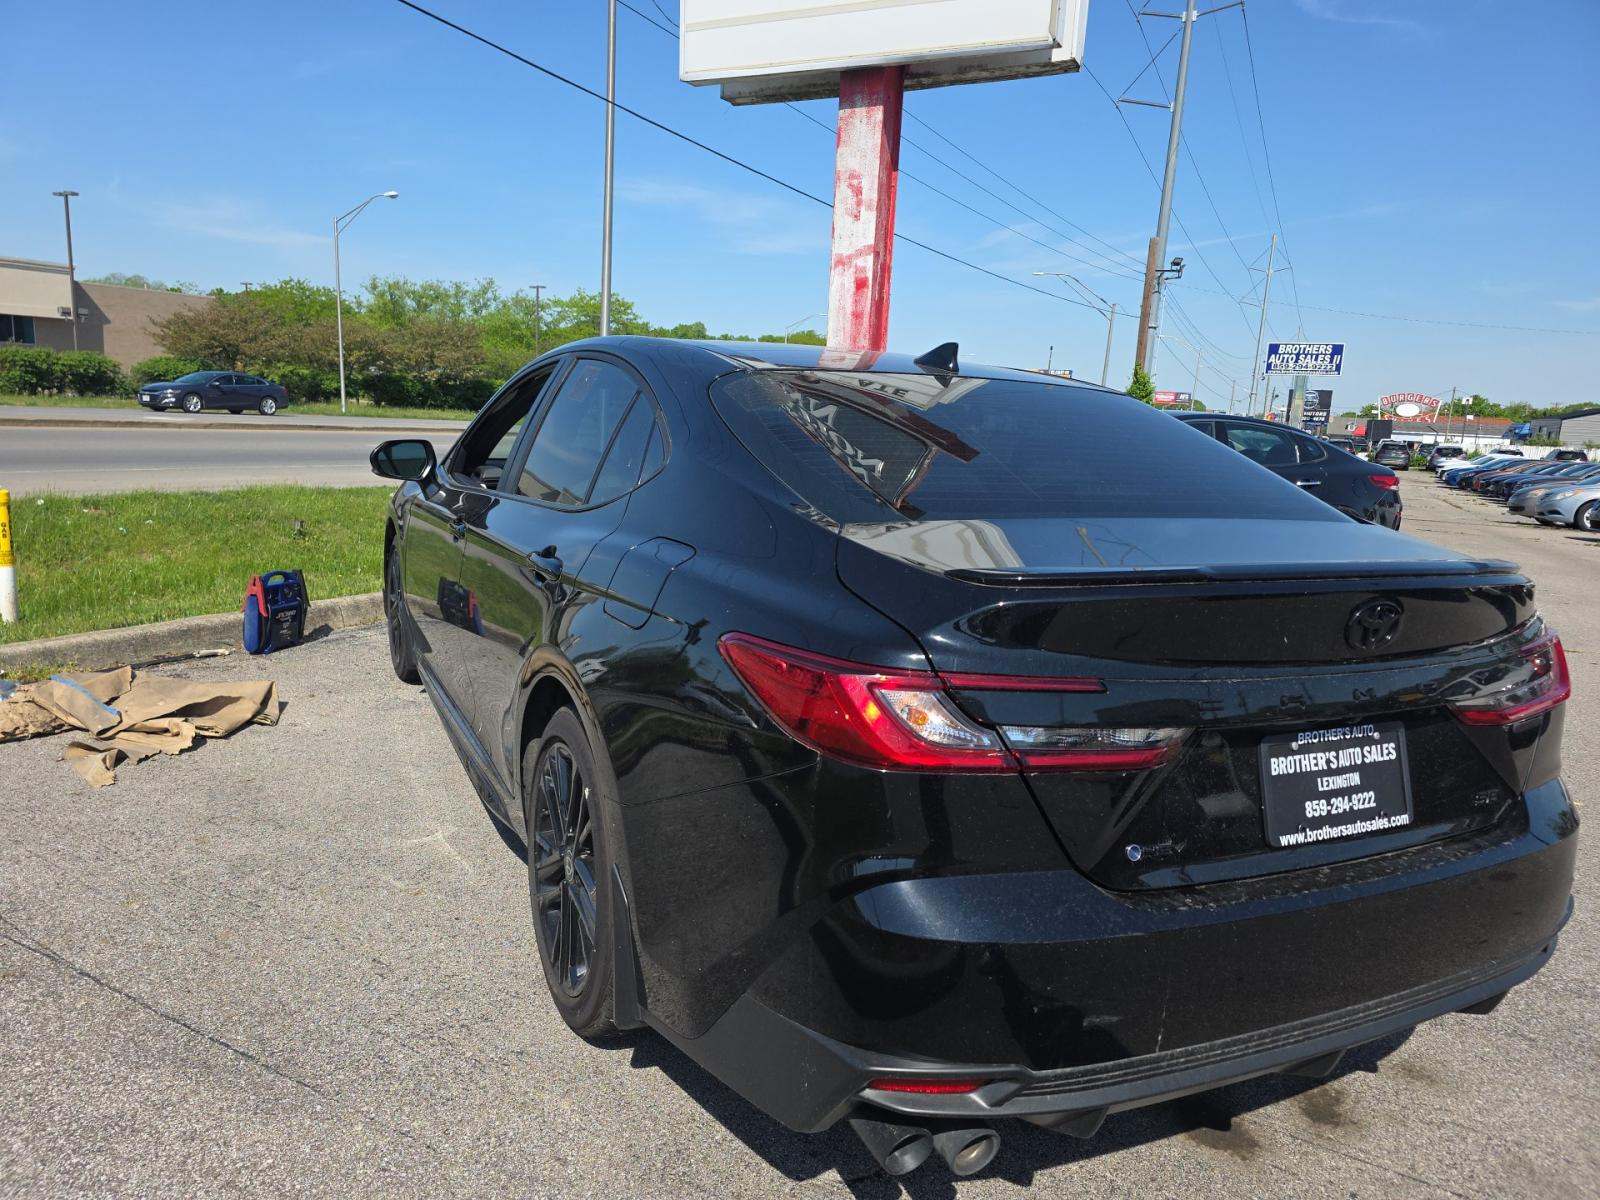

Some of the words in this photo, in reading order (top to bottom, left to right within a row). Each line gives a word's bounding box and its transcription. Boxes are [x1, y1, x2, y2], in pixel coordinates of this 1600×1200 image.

[1268, 355, 1296, 364] AUTO
[1298, 355, 1331, 364] SALES
[1278, 345, 1333, 354] BROTHERS
[1382, 393, 1439, 407] BURGERS
[1297, 727, 1350, 745] BROTHER'S
[1352, 724, 1374, 738] AUTO
[1270, 751, 1338, 776] BROTHER'S
[1338, 747, 1363, 767] AUTO
[1363, 742, 1396, 763] SALES
[1317, 772, 1361, 791] LEXINGTON
[1305, 791, 1376, 818] 859-294-9222
[1279, 814, 1409, 846] www.brothersautosales.com
